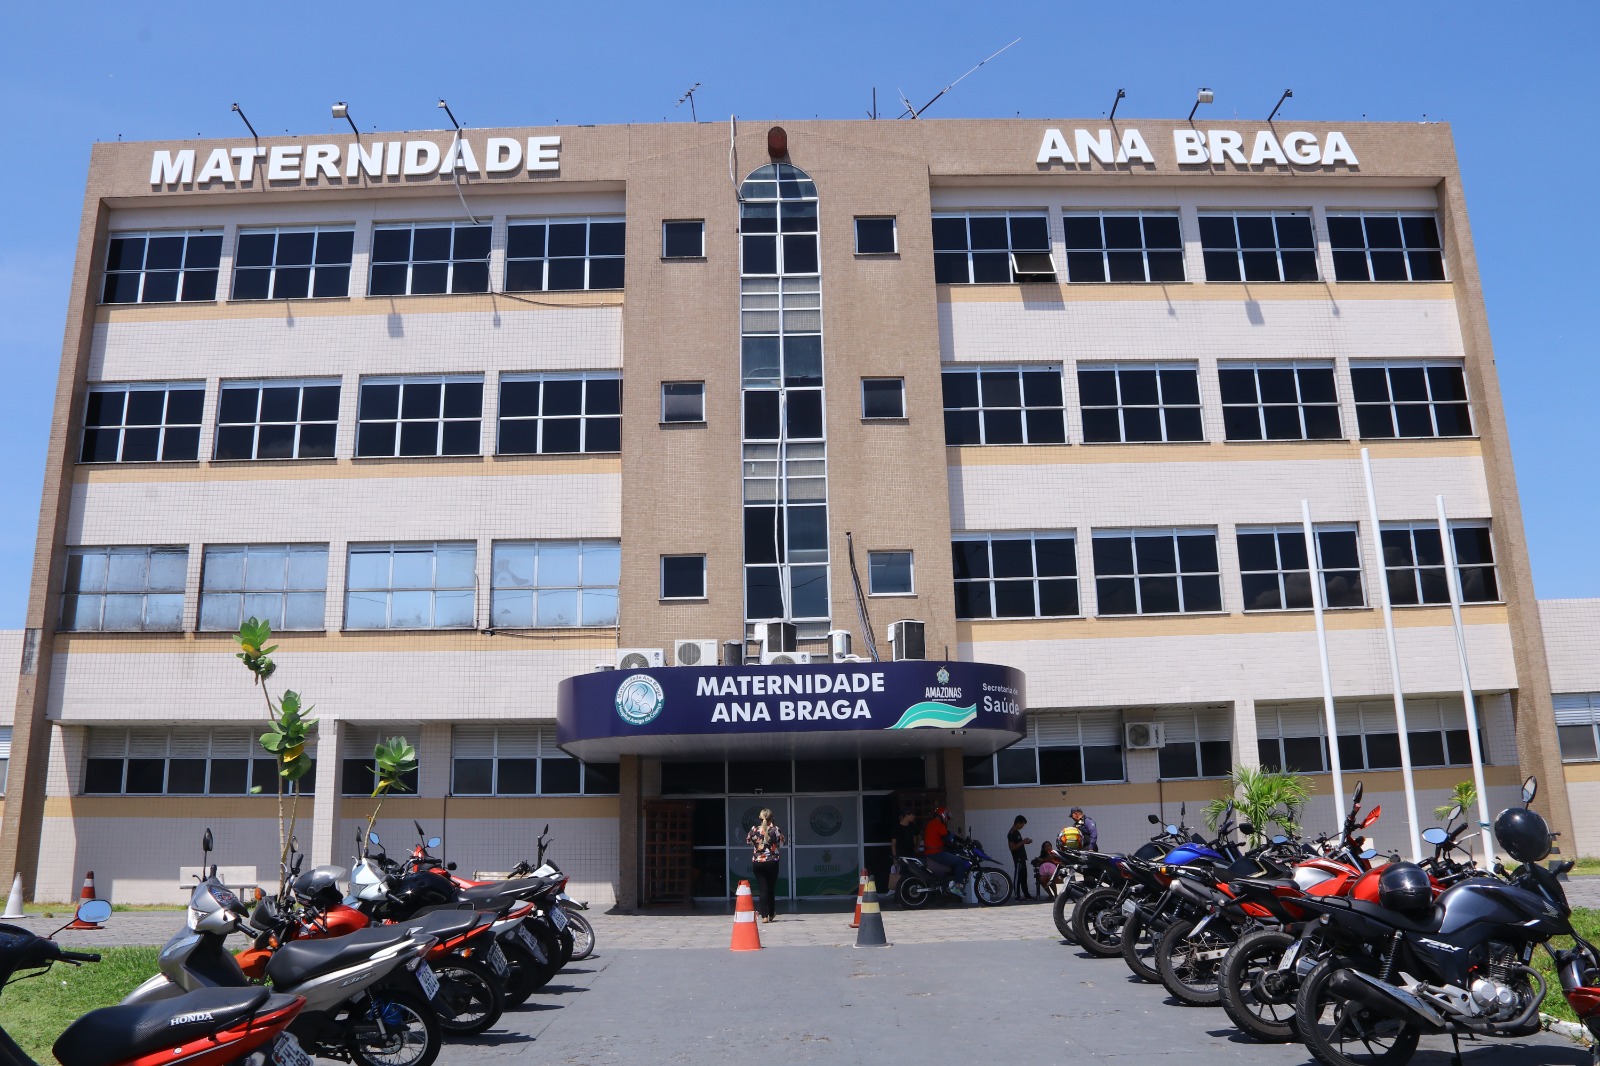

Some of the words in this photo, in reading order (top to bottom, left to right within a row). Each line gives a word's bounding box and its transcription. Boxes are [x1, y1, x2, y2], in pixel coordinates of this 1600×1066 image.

[1036, 128, 1155, 164] ANA
[1173, 129, 1360, 166] BRAGA
[149, 135, 562, 186] MATERNIDADE
[696, 672, 885, 697] MATERNIDADE
[925, 686, 962, 699] AMAZONAS
[982, 682, 1013, 694] Secretaria
[1012, 687, 1019, 695] de
[711, 701, 772, 723] ANA
[779, 699, 872, 721] BRAGA
[983, 695, 1020, 716] Saúde
[170, 1011, 214, 1026] HONDA
